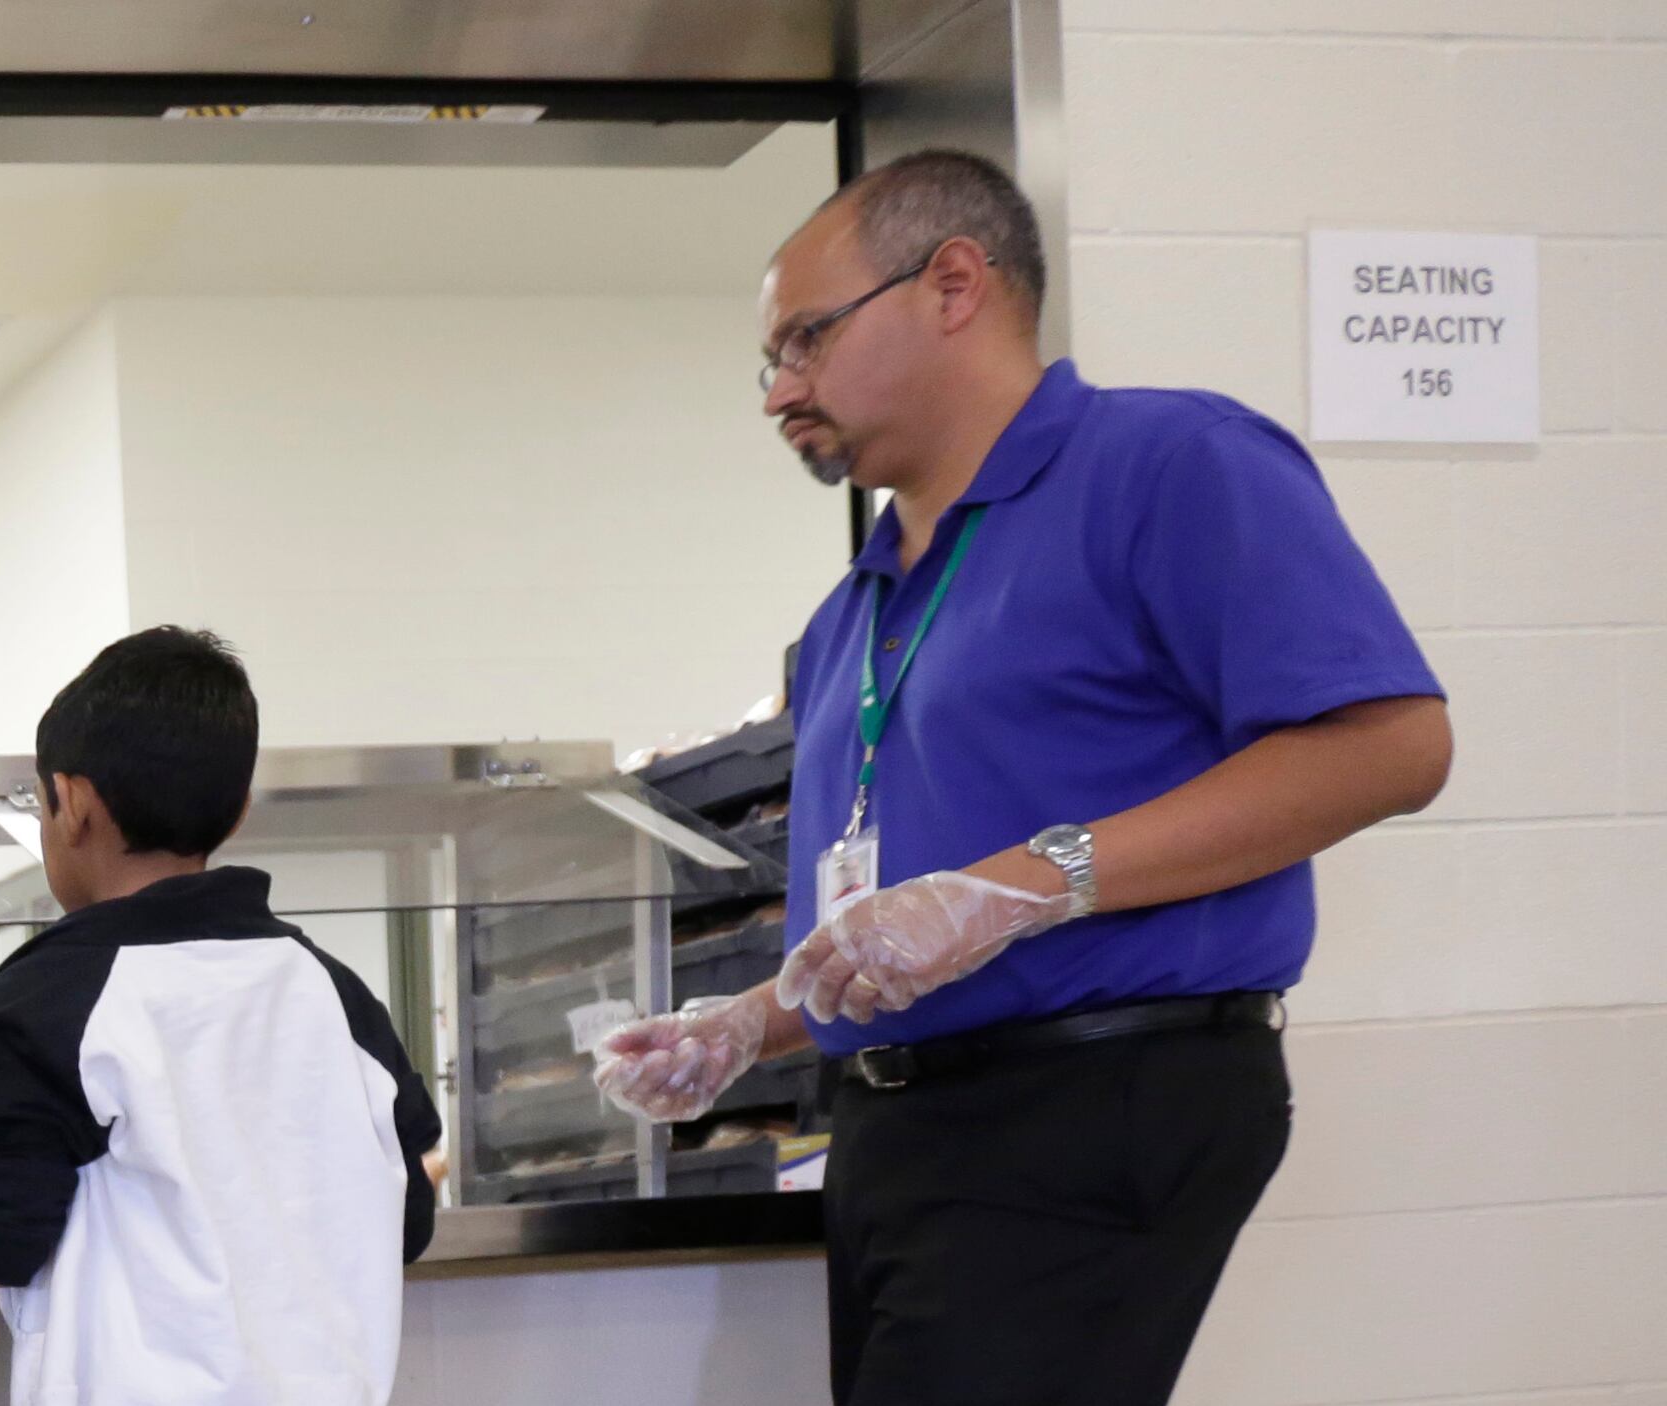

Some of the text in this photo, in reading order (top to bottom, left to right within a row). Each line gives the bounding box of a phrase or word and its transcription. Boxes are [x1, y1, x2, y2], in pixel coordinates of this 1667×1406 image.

[1354, 265, 1494, 295] SEATING
[1344, 315, 1505, 344] CAPACITY
[1402, 368, 1453, 396] 156
